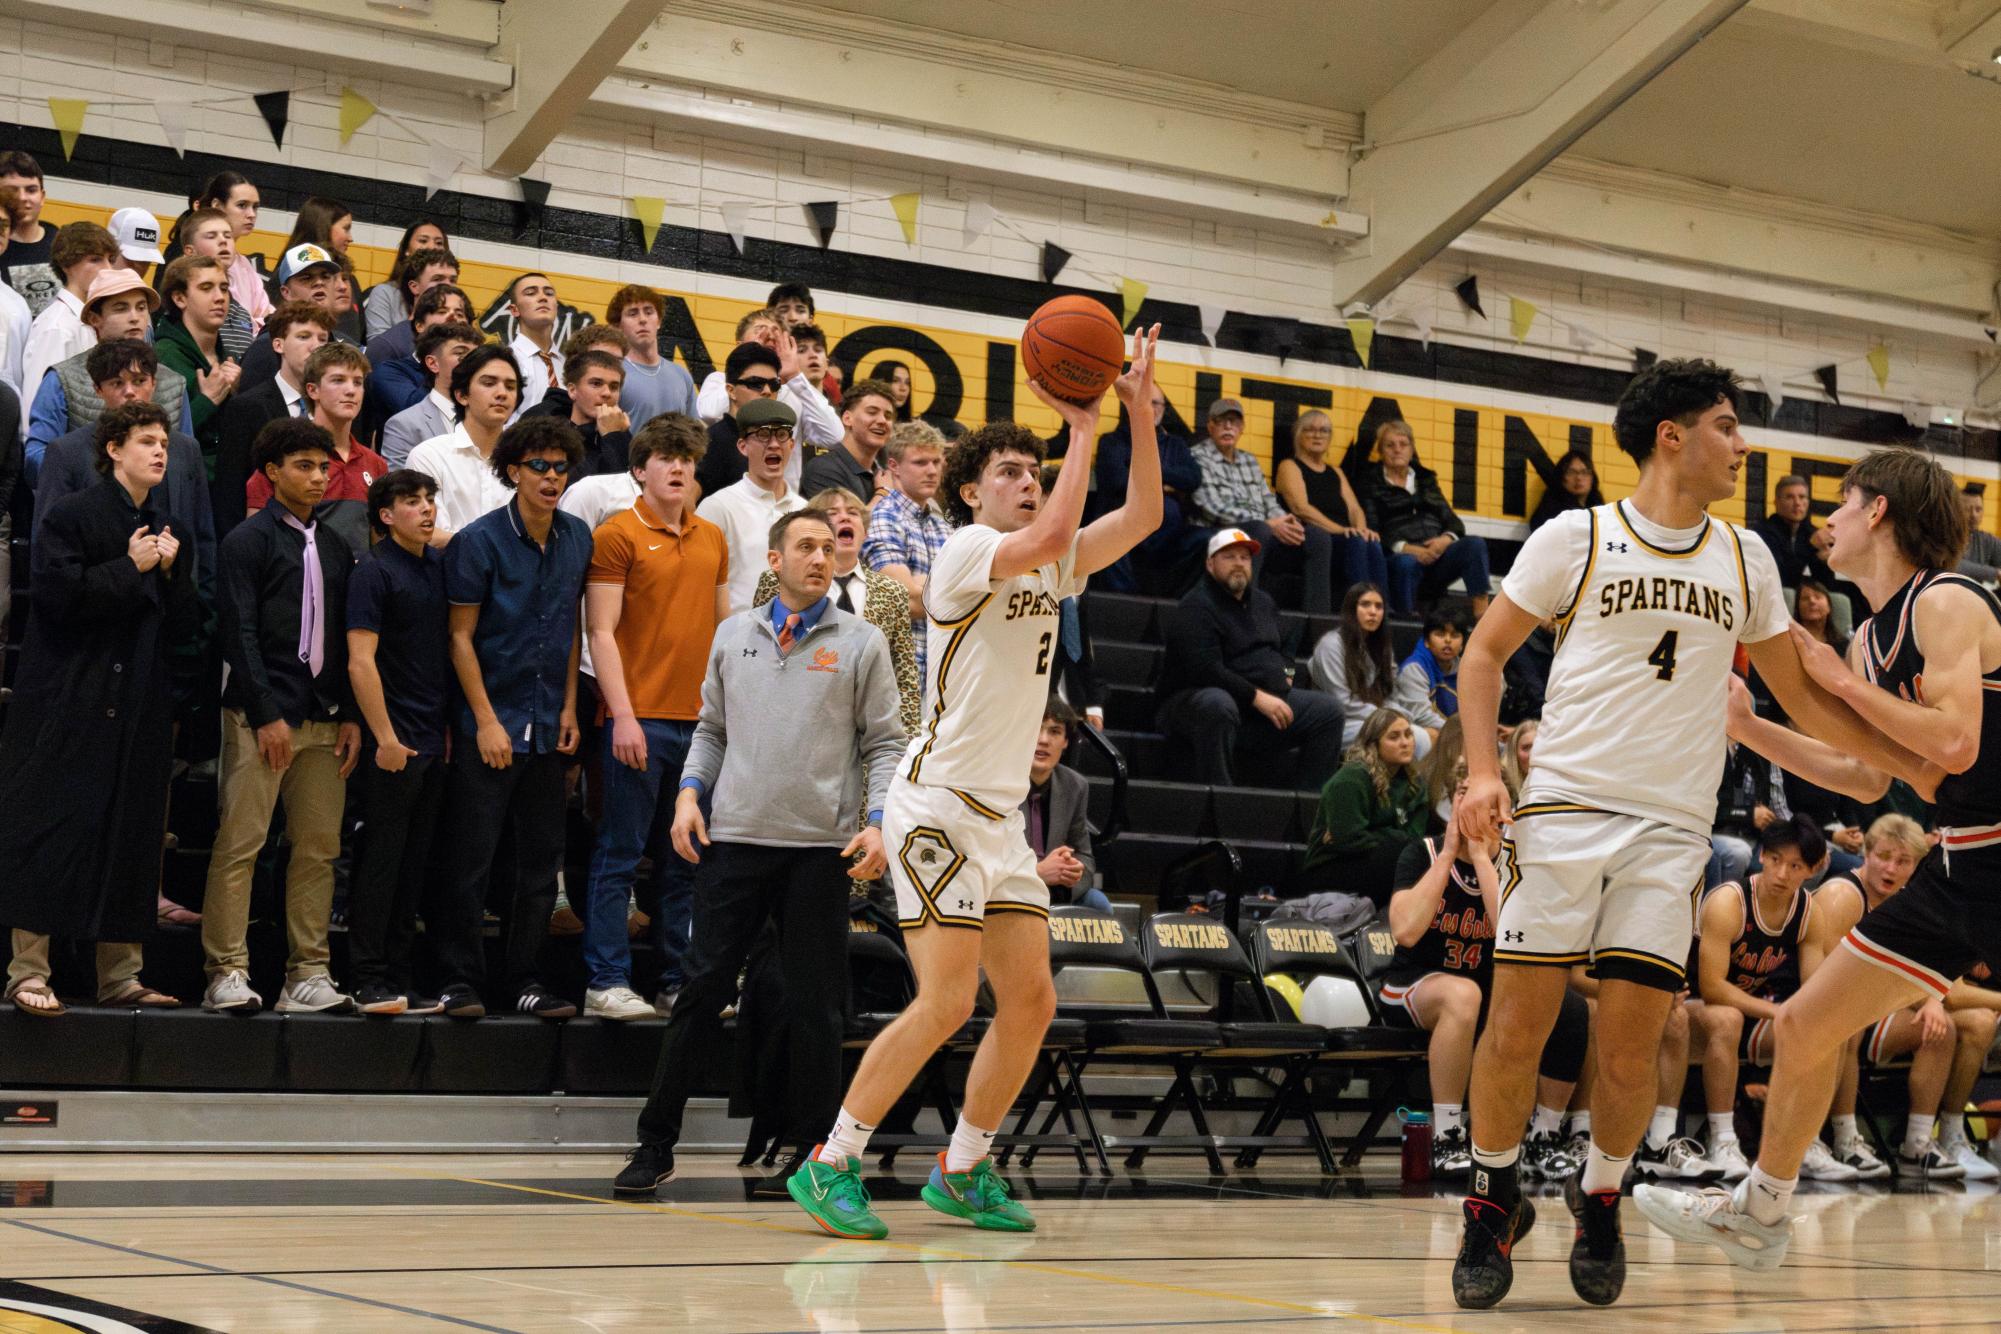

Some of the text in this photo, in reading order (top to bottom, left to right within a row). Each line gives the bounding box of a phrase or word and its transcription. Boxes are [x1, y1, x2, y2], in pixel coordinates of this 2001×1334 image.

[136, 230, 156, 240] Huk
[1600, 577, 1734, 632] SPARTANS
[1035, 631, 1052, 675] 2
[1648, 629, 1679, 682] 4
[1048, 917, 1124, 944] SPARTANS
[1154, 924, 1229, 949] SPARTANS
[1266, 928, 1338, 954] SPARTANS
[1368, 932, 1398, 955] SPA
[1443, 938, 1482, 969] 34
